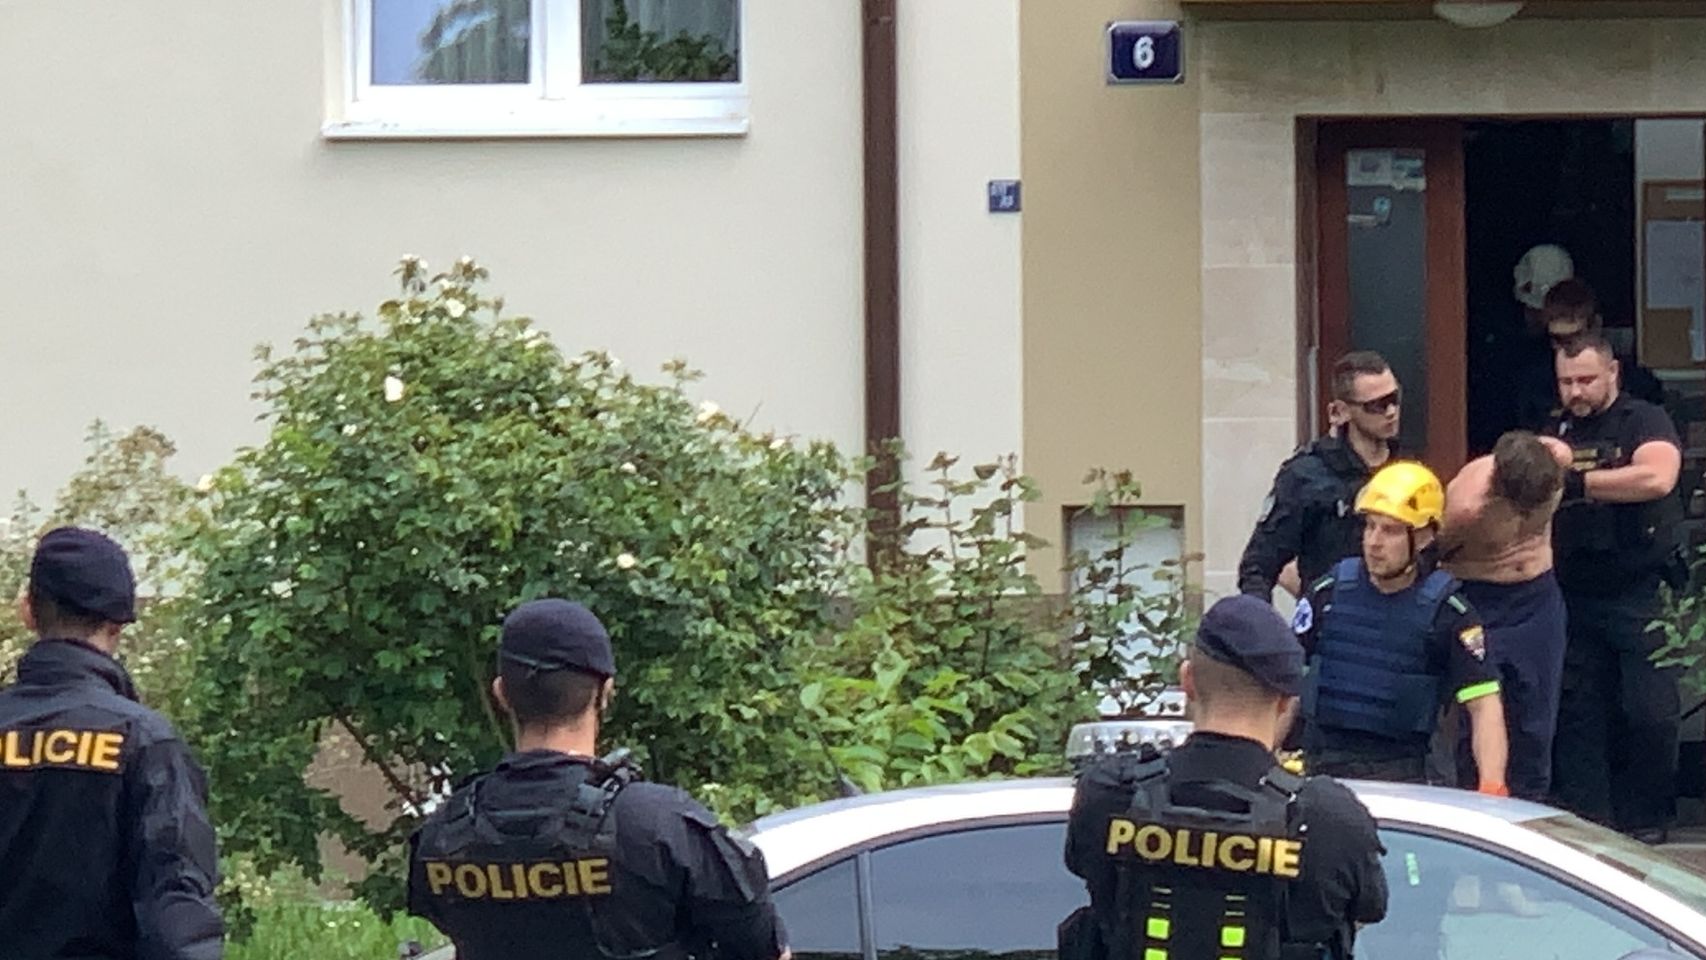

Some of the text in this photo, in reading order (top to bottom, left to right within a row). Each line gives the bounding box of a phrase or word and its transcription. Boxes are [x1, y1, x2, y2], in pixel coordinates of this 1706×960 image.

[1132, 35, 1155, 70] 6
[0, 730, 124, 769] LICIE
[1106, 818, 1302, 877] POLICIE
[425, 858, 612, 899] POLICIE
